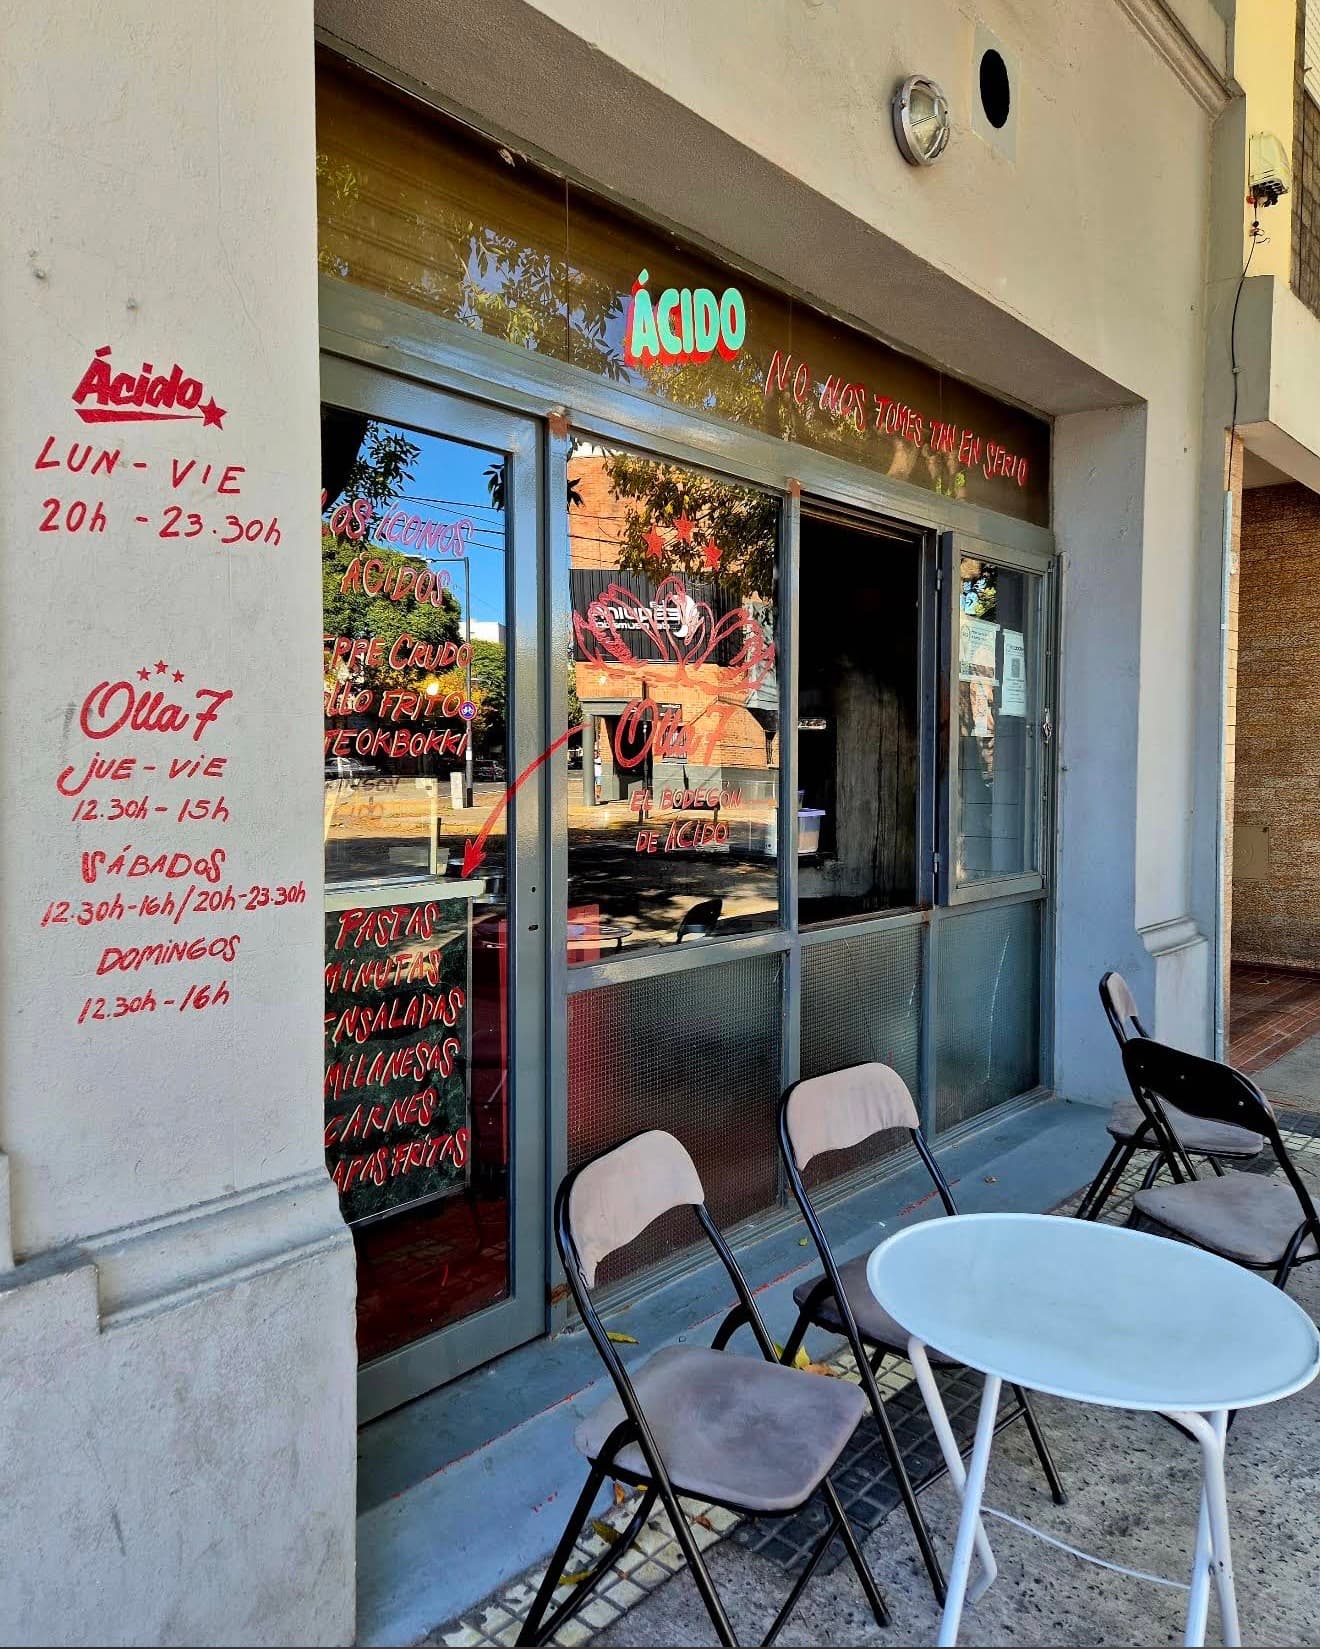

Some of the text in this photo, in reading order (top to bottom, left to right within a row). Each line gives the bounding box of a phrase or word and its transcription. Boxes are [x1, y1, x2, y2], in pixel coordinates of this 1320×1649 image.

[627, 268, 746, 365] ÁCIDO
[72, 345, 203, 409] Ácido
[764, 350, 1029, 487] NO NOS TOMES TAN EN SERIO
[34, 436, 121, 475] LUN
[172, 459, 246, 494] VIE
[39, 498, 107, 532] 20h
[159, 506, 282, 546] 23.30h
[340, 552, 451, 607] ÁCIDOS
[389, 632, 474, 671] CRUDO
[80, 681, 234, 741] Olla 7
[379, 688, 466, 721] FRITO
[614, 698, 701, 768] Olla
[630, 789, 653, 812] EL
[82, 844, 226, 883] SÁBADOS
[635, 830, 660, 854] DE
[335, 902, 440, 950] PASTAS
